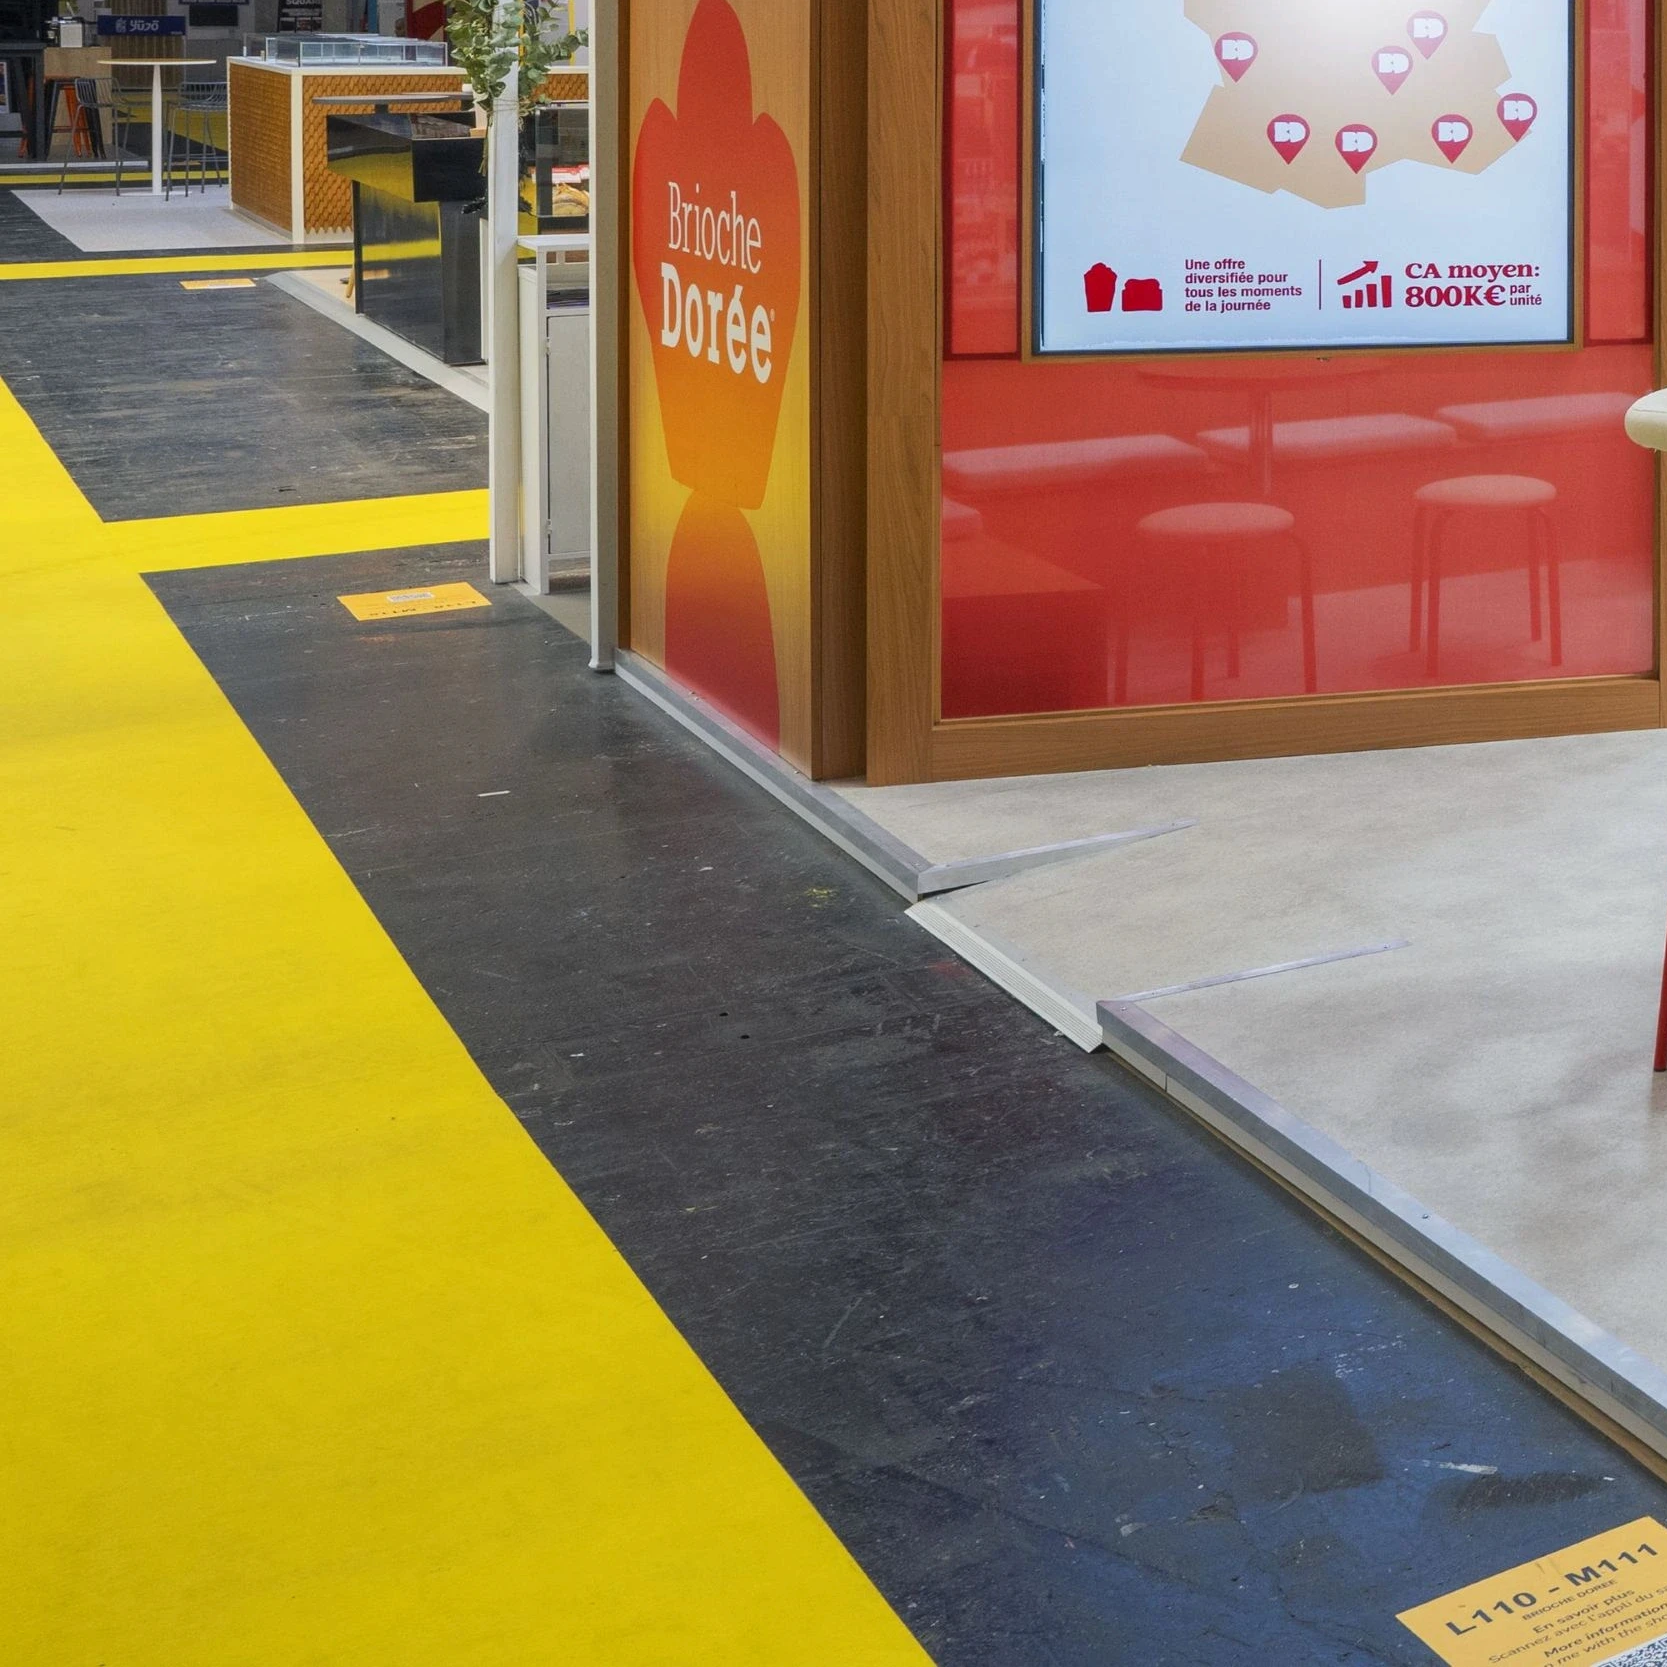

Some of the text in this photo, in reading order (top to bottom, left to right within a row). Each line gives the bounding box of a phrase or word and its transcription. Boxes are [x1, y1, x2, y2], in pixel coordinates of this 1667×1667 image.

[668, 181, 762, 274] Brioche
[1185, 258, 1246, 270] Une offre
[1405, 262, 1541, 283] CA moyen:
[1185, 271, 1289, 286] diversifiée pour
[1185, 285, 1303, 298] tous les moments
[1404, 284, 1507, 308] 800K€
[1509, 285, 1532, 297] par
[1509, 294, 1543, 307] unité
[1185, 299, 1272, 314] de la journée
[661, 261, 773, 384] Dorée
[1445, 1592, 1538, 1636] L110
[1564, 1543, 1659, 1587] M111
[1522, 1596, 1576, 1621] BRIOCHE
[1533, 1589, 1636, 1634] En savoir plus
[1488, 1635, 1552, 1664] Scannez
[1555, 1619, 1588, 1637] avec
[1634, 1593, 1654, 1604] du
[1543, 1637, 1583, 1658] More
[1557, 1651, 1581, 1665] me
[1583, 1636, 1617, 1654] with
[1618, 1625, 1643, 1639] the
